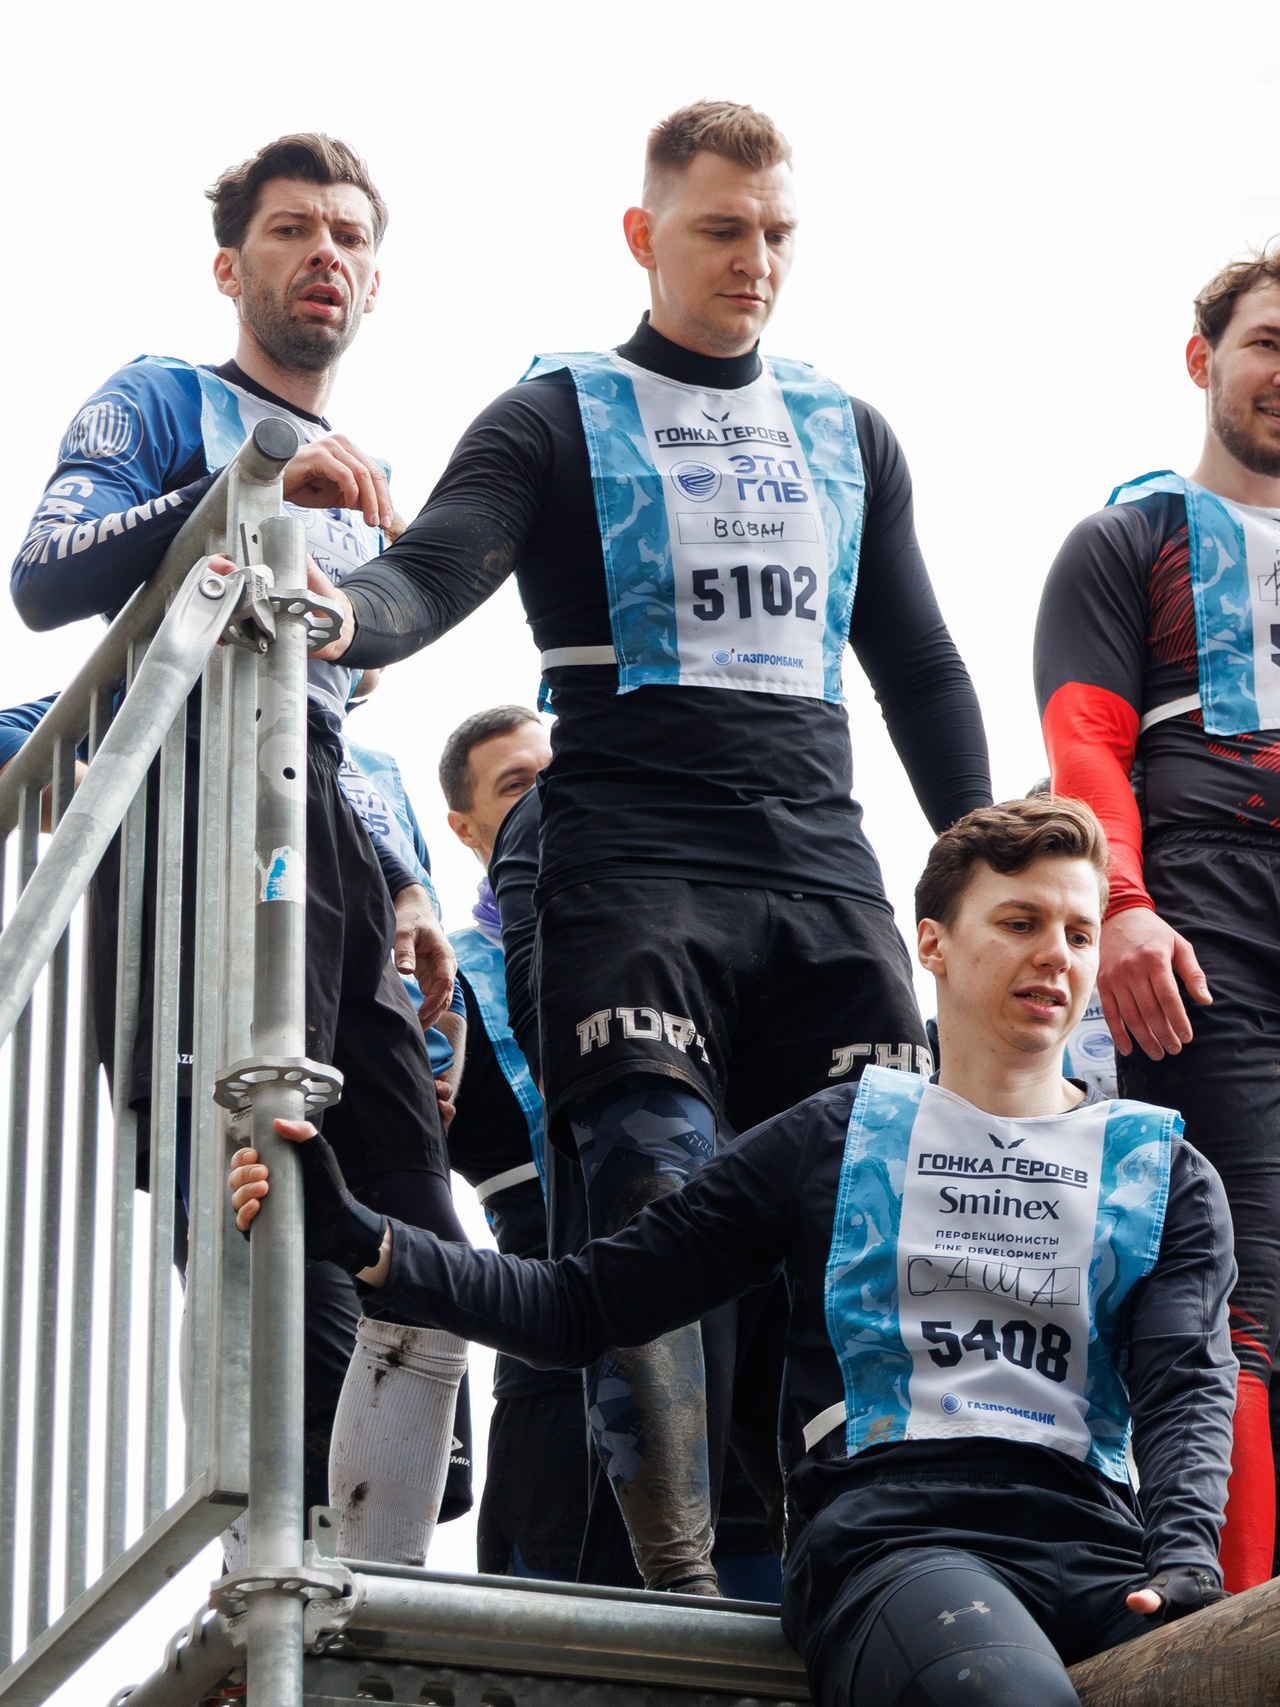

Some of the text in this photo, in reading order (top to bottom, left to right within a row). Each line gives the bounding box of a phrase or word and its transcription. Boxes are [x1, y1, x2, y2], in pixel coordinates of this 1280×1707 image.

[654, 426, 790, 444] ГОНКА ГЕРОЕВ
[727, 454, 802, 479] ЭТП
[735, 478, 809, 503] ГПБ
[713, 516, 786, 539] ВОВАН
[691, 564, 817, 622] 5102
[736, 653, 805, 669] ГАЗПРОМБАНК
[917, 1153, 1089, 1184] ГОНКА ГЕРОЕВ
[938, 1186, 1060, 1221] Sminex
[935, 1229, 1060, 1246] ПЕРФЕКЦИОНИСТЫ
[934, 1243, 1058, 1261] FINE DEVELOPMENT
[907, 1256, 1072, 1309] САША
[920, 1319, 1072, 1384] 5408
[966, 1400, 1056, 1426] ГАЗПРОМБАНК
